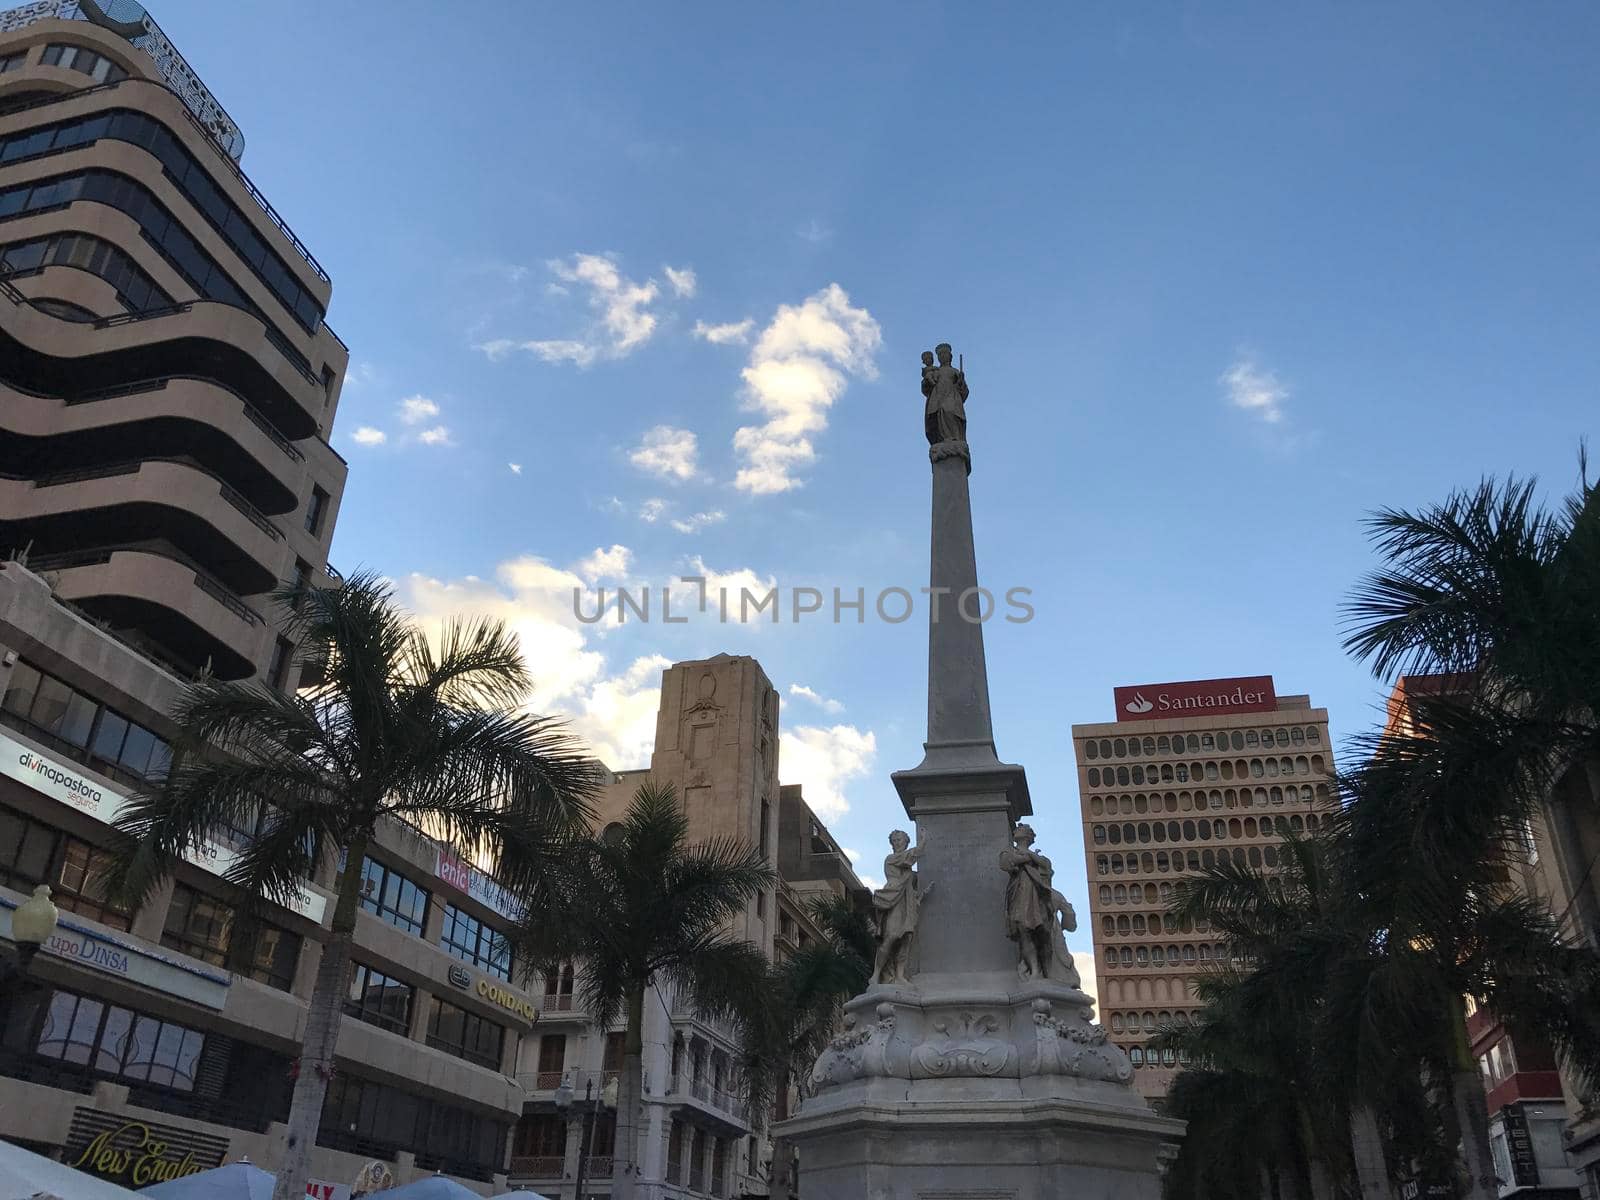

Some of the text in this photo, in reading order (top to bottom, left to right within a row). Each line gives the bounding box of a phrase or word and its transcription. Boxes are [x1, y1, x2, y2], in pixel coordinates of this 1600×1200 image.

[1158, 687, 1265, 711] Santander
[19, 753, 102, 802] divinapastora
[67, 791, 98, 811] seguros
[50, 936, 79, 954] upo
[71, 1123, 207, 1185] New Engla
